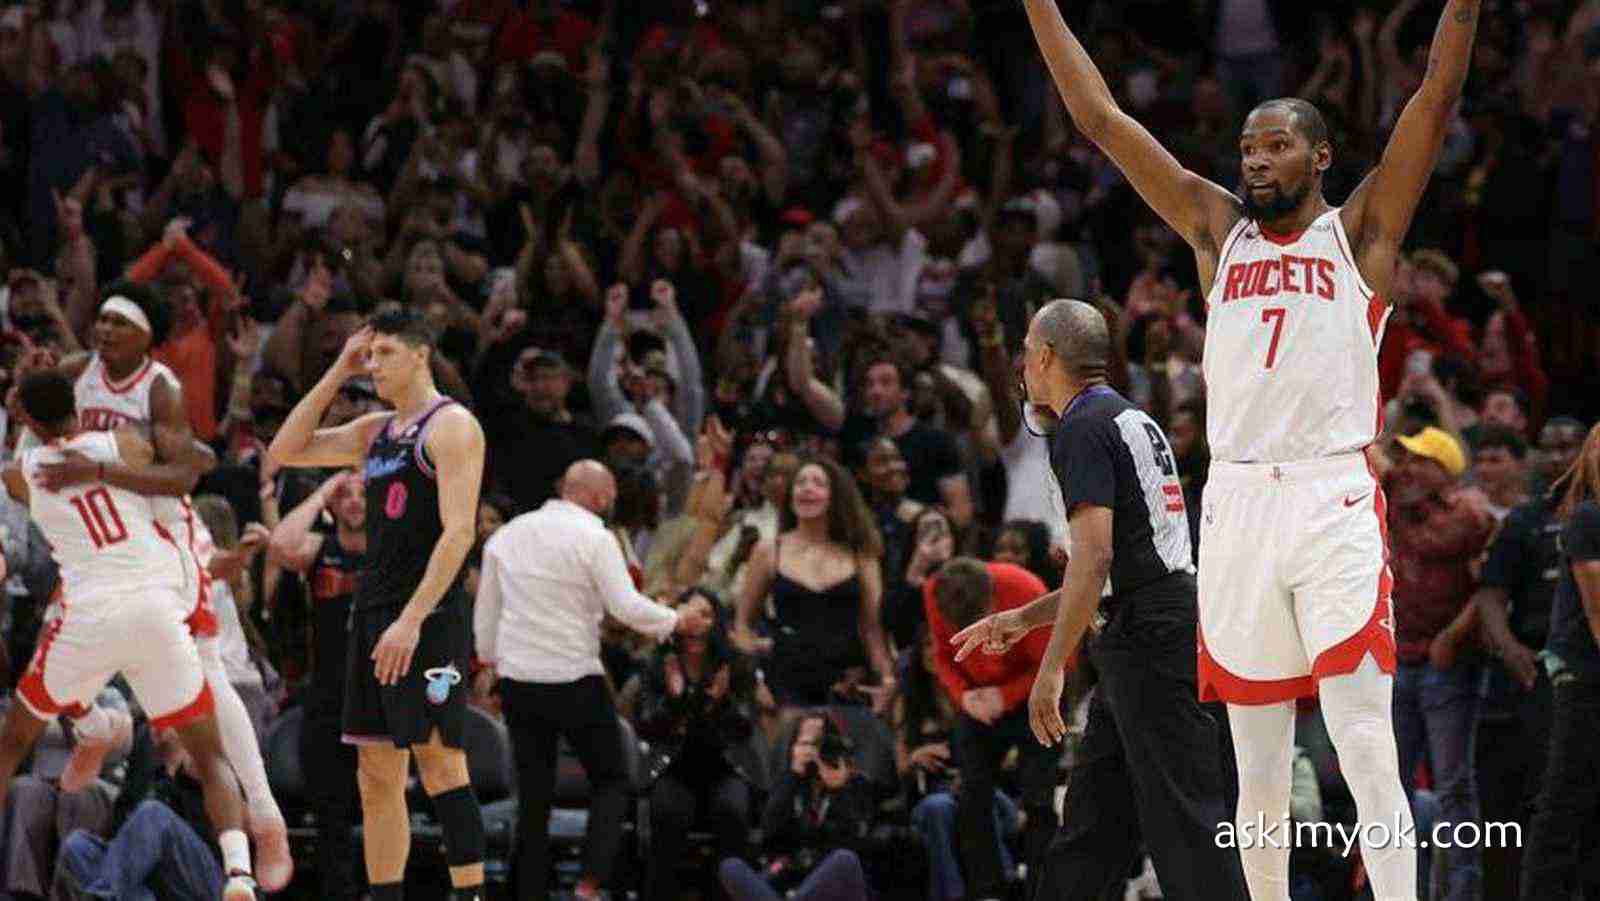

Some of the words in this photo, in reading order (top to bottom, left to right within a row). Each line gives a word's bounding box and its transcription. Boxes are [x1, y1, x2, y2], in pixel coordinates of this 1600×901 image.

[1222, 253, 1335, 303] ROCETS
[1262, 307, 1286, 369] 7
[69, 486, 128, 549] 10
[385, 481, 408, 519] 0
